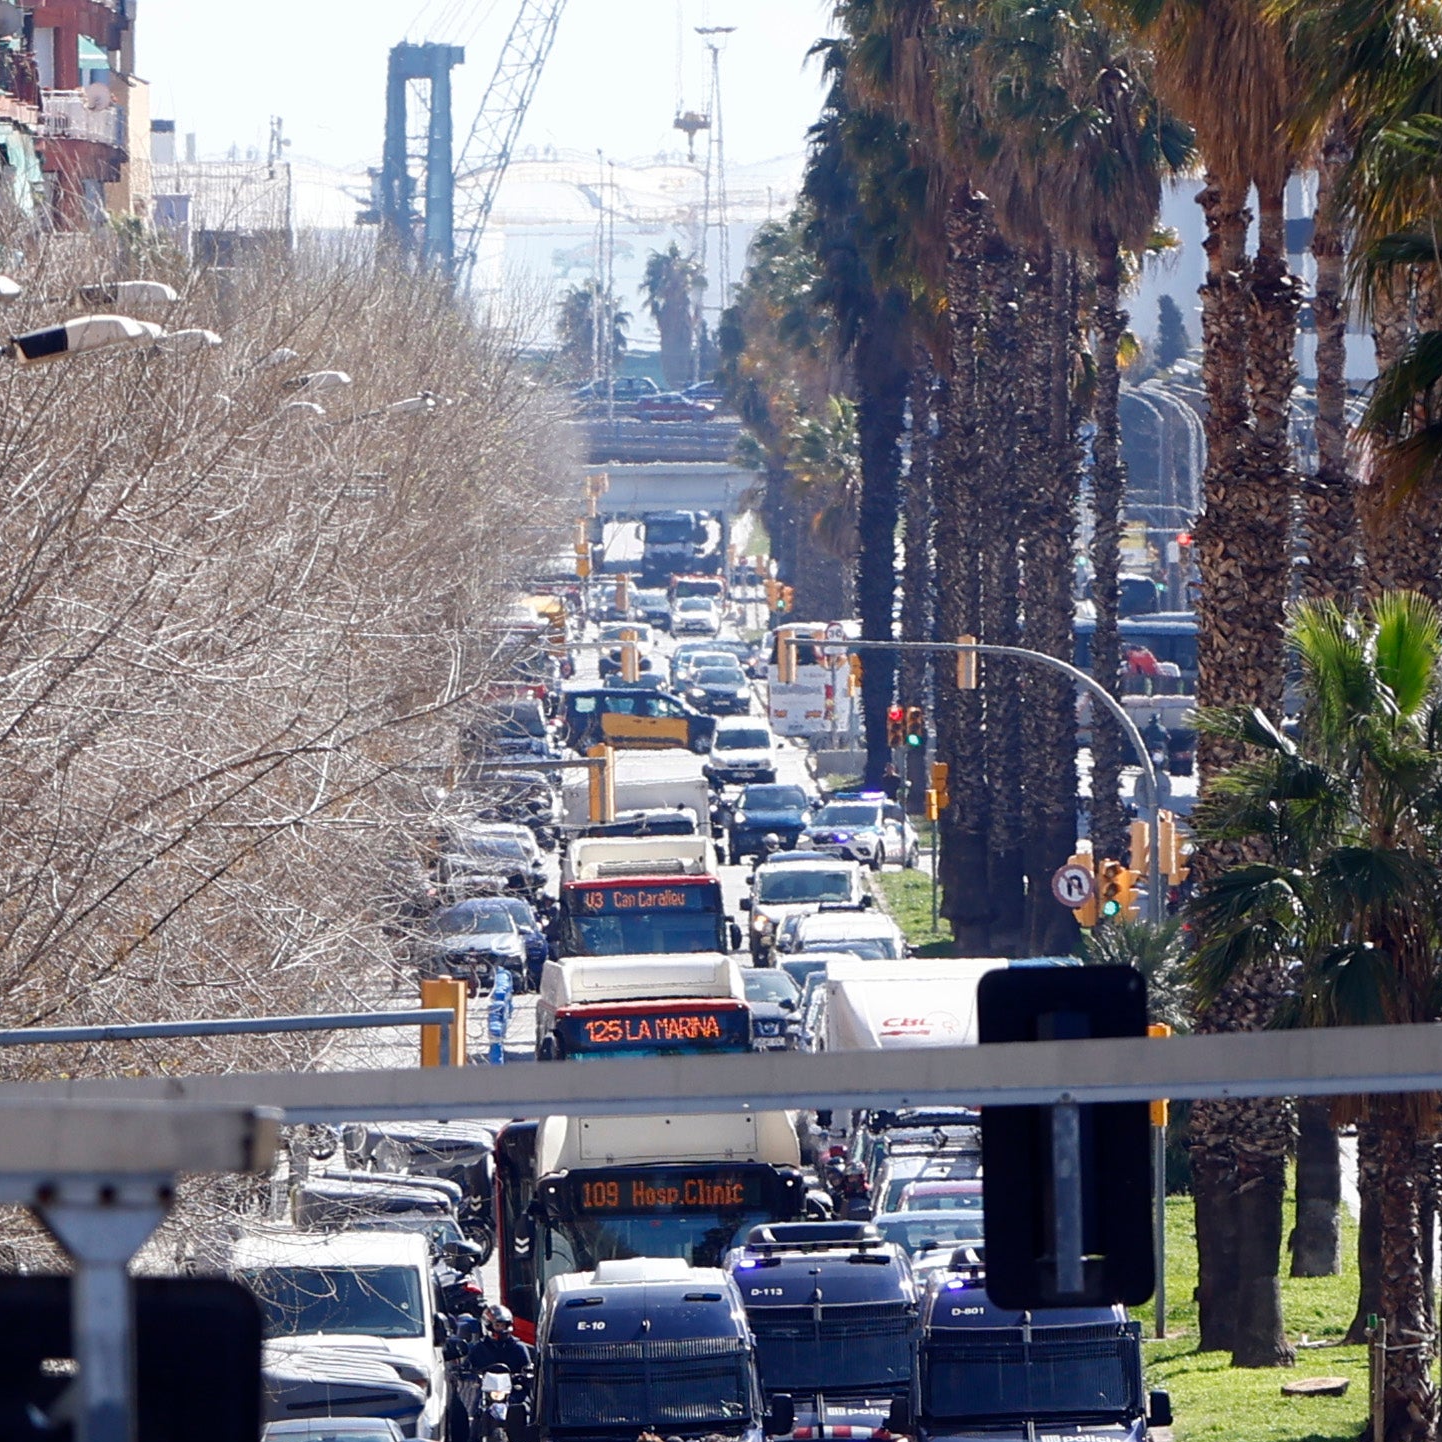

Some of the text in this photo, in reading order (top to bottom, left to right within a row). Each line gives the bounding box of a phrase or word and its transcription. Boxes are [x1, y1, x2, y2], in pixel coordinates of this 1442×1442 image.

[614, 891, 636, 908] Can
[585, 1015, 720, 1042] 125 LA MARINA
[583, 1181, 620, 1207] 109
[751, 1288, 783, 1296] D-113
[951, 1307, 984, 1316] D-801
[577, 1321, 606, 1331] E-10
[847, 1408, 891, 1417] polic
